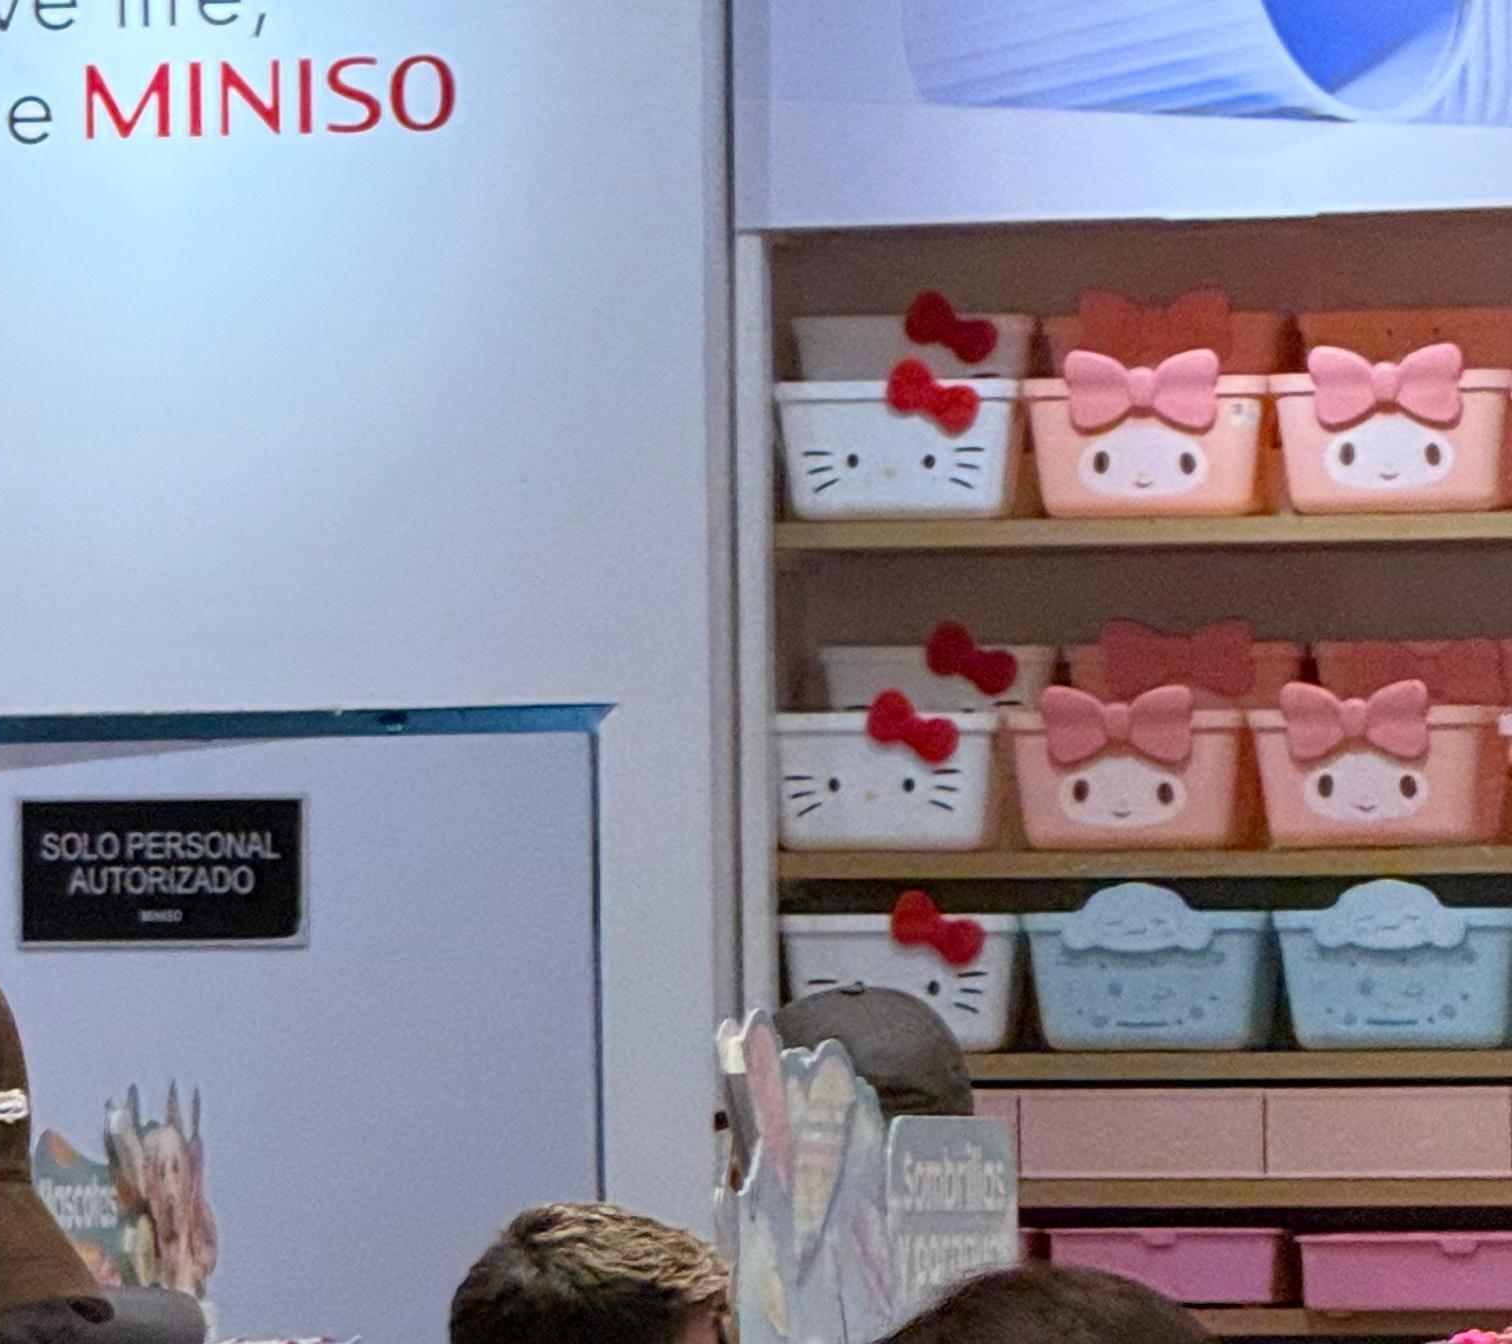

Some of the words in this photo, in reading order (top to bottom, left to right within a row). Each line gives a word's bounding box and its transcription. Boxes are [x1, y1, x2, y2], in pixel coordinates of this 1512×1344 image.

[85, 54, 456, 140] MINISO
[41, 832, 120, 861] SOLO
[127, 831, 281, 860] PERSONAL
[68, 865, 255, 895] AUTORIZADO
